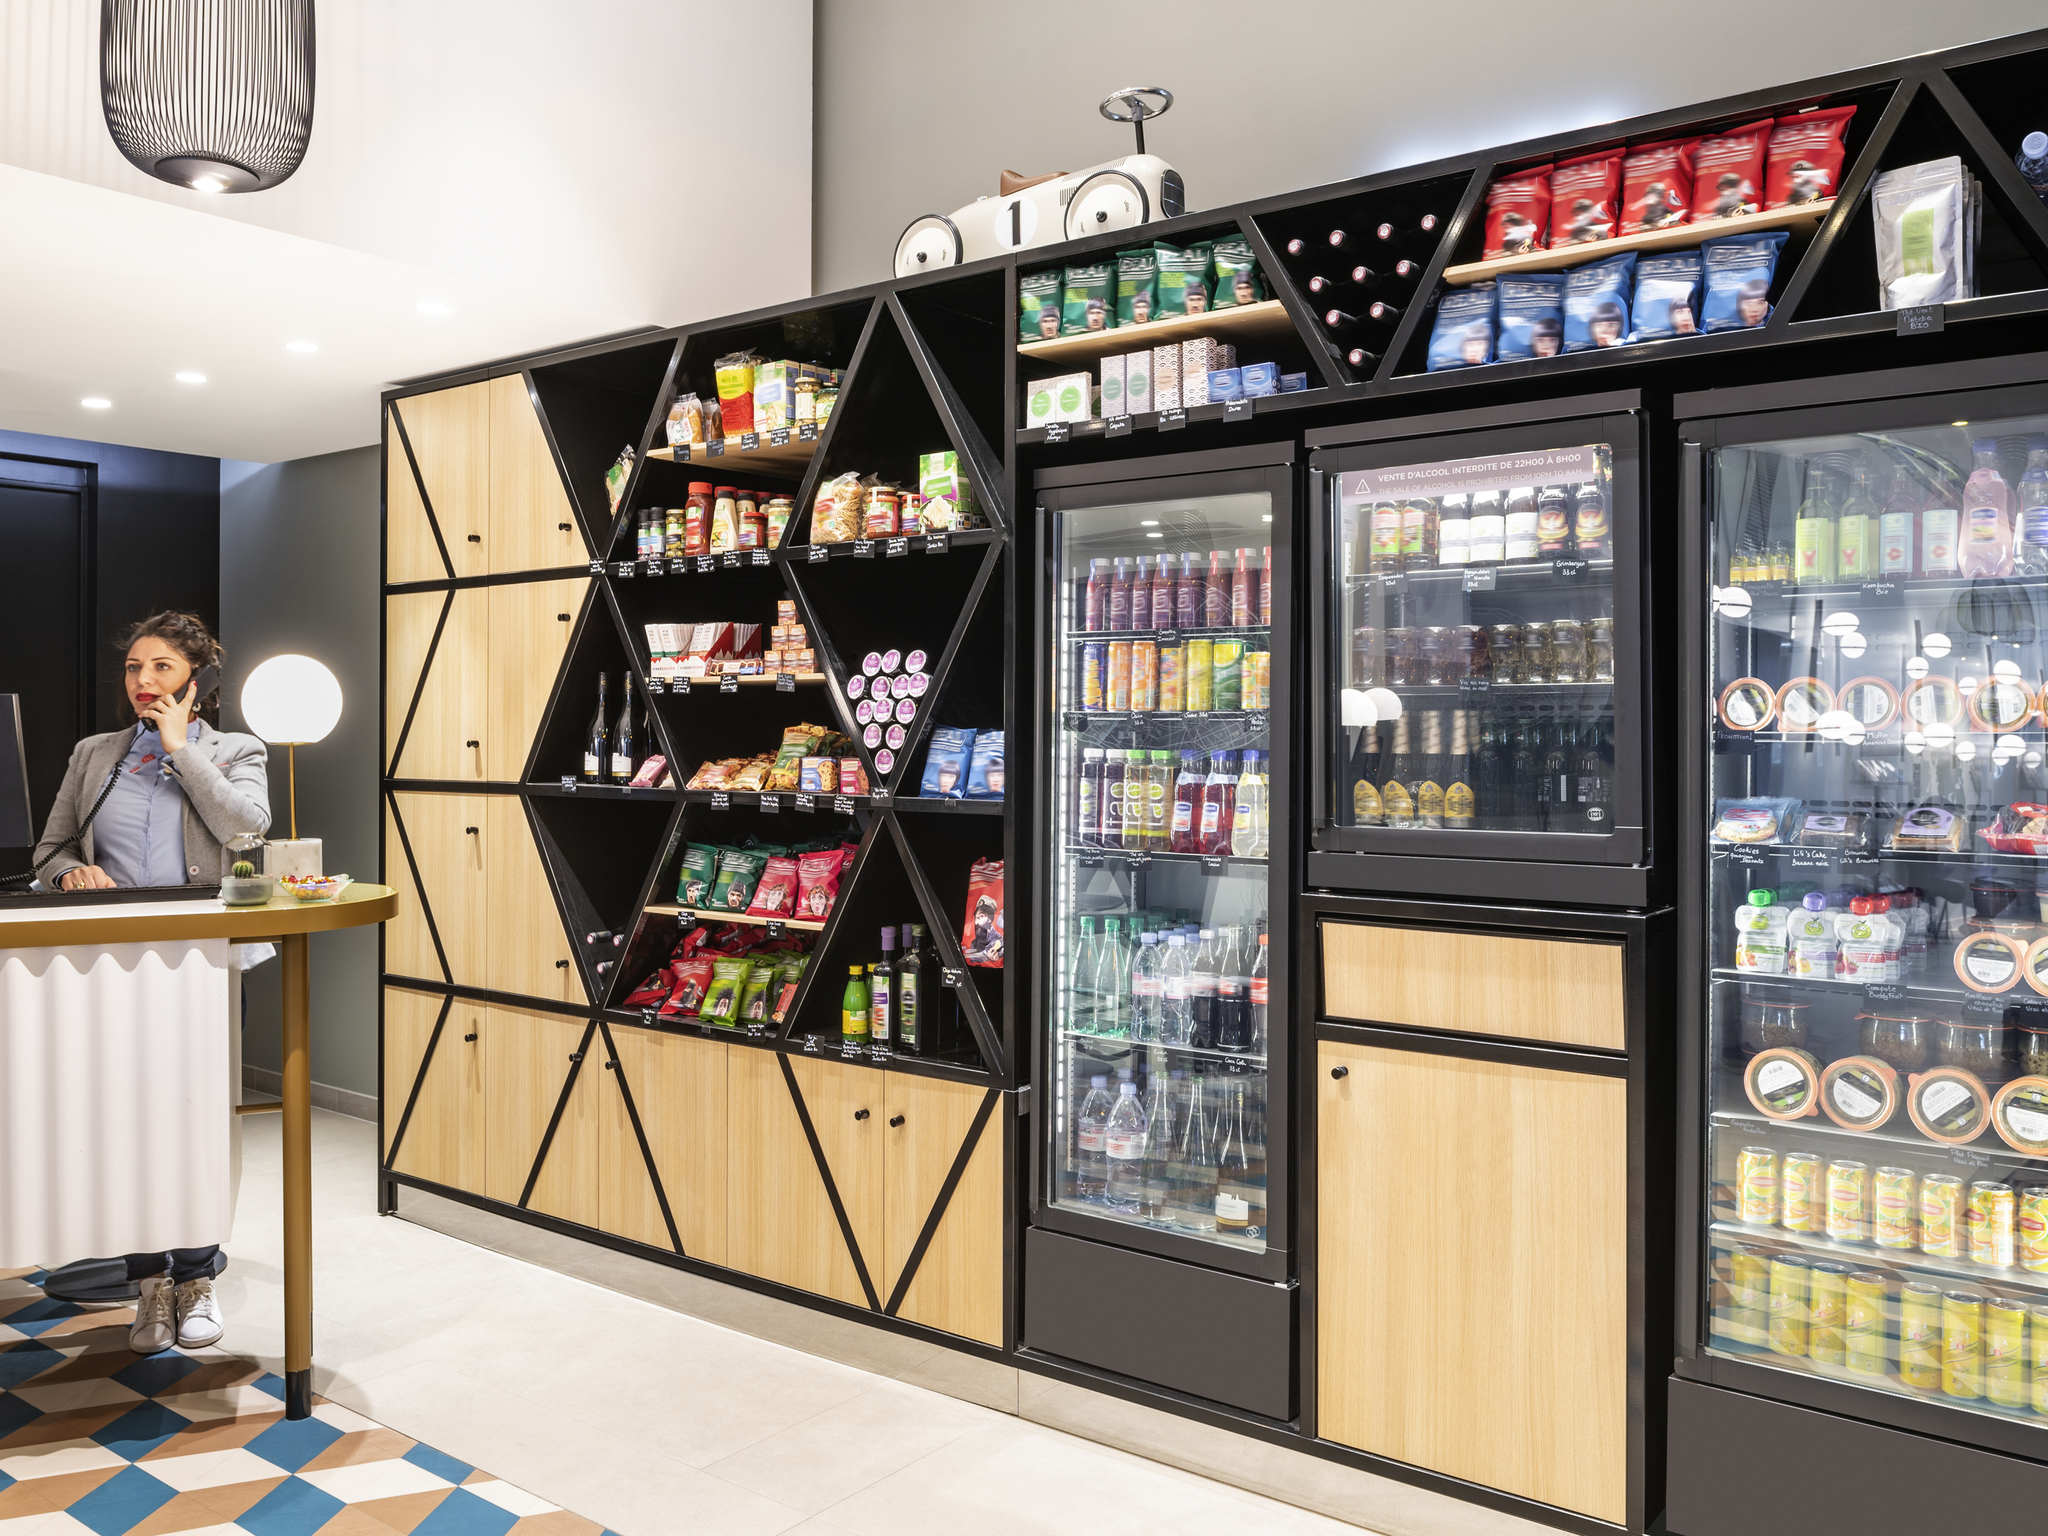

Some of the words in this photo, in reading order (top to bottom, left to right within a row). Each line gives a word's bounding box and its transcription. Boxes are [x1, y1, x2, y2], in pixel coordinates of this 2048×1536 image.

[1007, 200, 1022, 246] 1
[1378, 472, 1406, 482] VENTE
[1407, 468, 1450, 480] D'ALCOOL
[1452, 461, 1499, 475] INTERDITE
[1500, 461, 1512, 469] DE
[1514, 458, 1544, 468] 22H00
[1546, 454, 1554, 464] À
[1510, 472, 1533, 481] FROM
